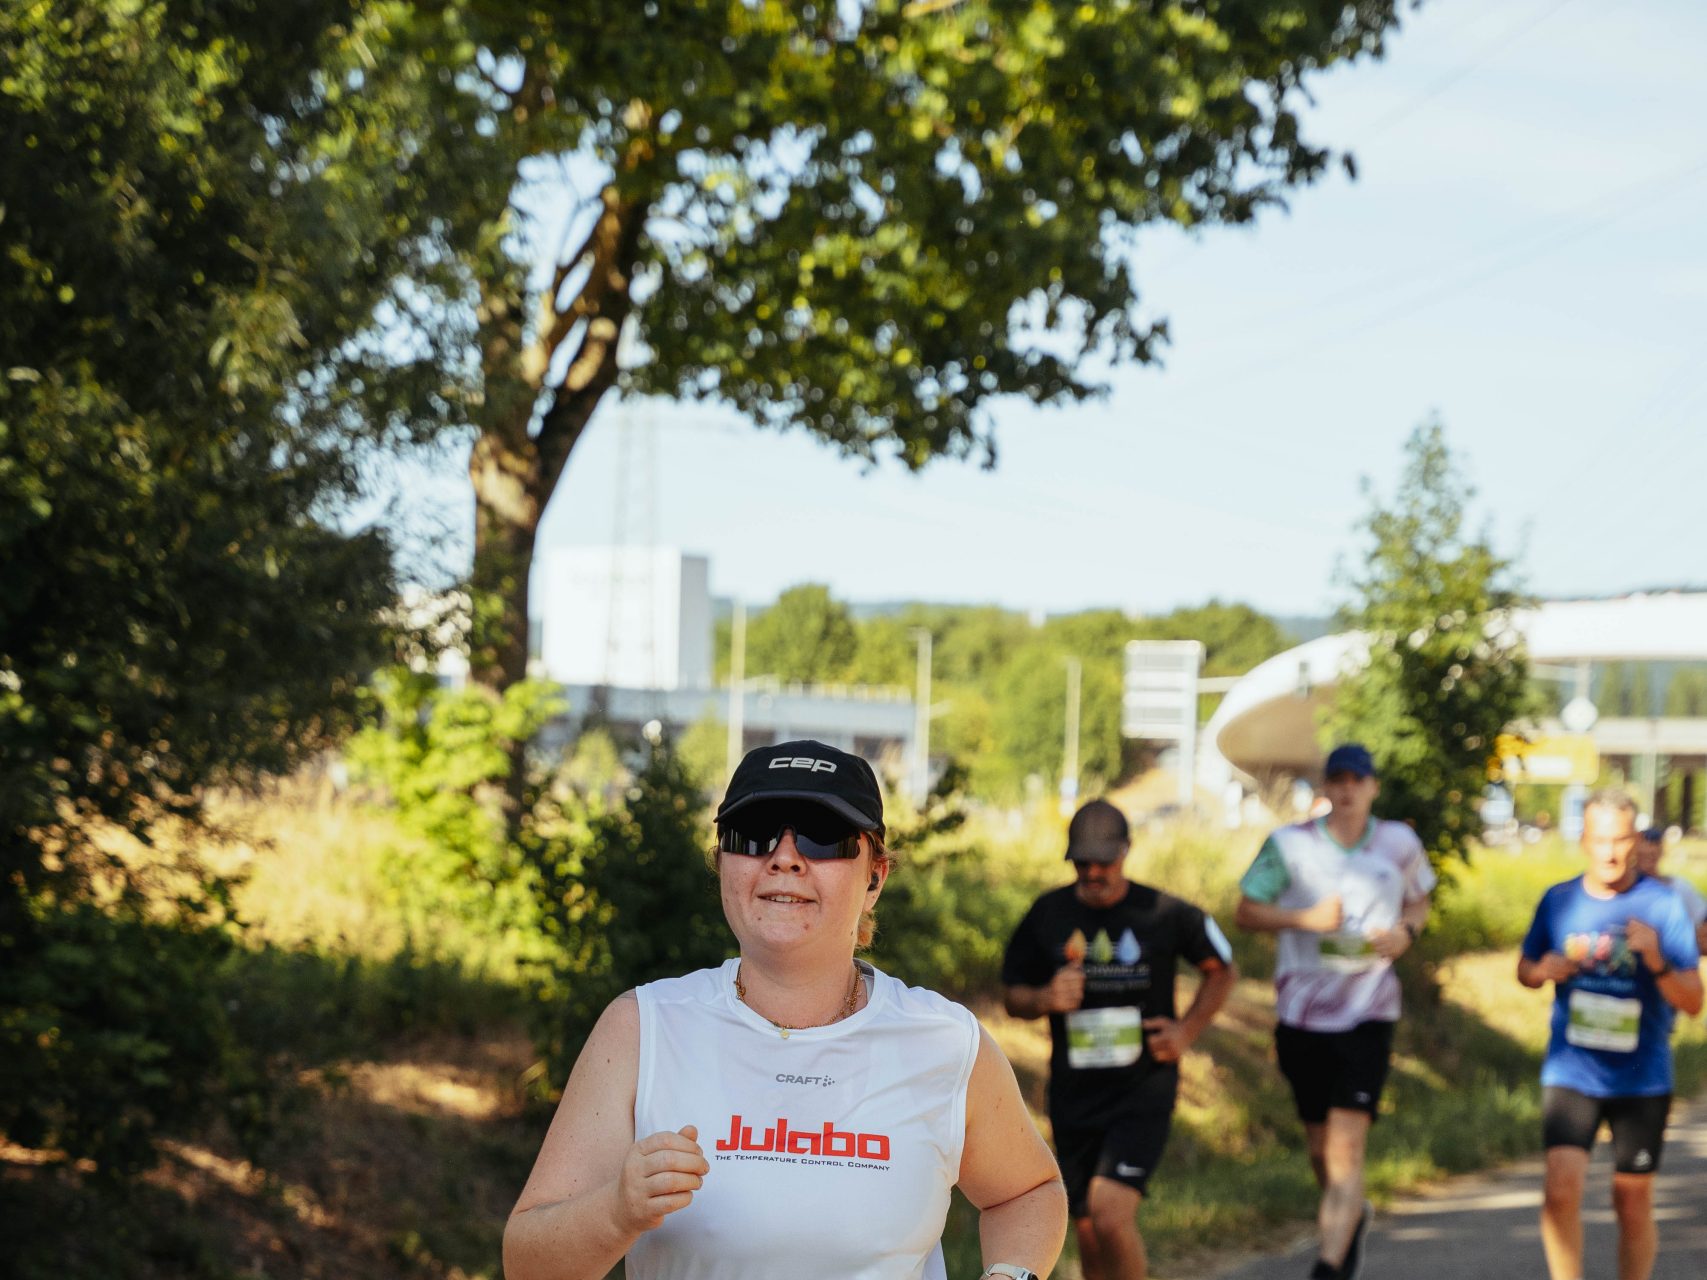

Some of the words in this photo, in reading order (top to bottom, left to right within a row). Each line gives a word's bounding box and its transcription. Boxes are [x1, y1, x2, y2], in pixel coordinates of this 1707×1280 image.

[768, 757, 838, 774] cep
[775, 1073, 822, 1085] CRAFT
[715, 1115, 891, 1162] Julabo
[734, 1154, 797, 1163] TEMPERATURE
[801, 1158, 844, 1167] CONTROL
[848, 1161, 890, 1171] COMPANY
